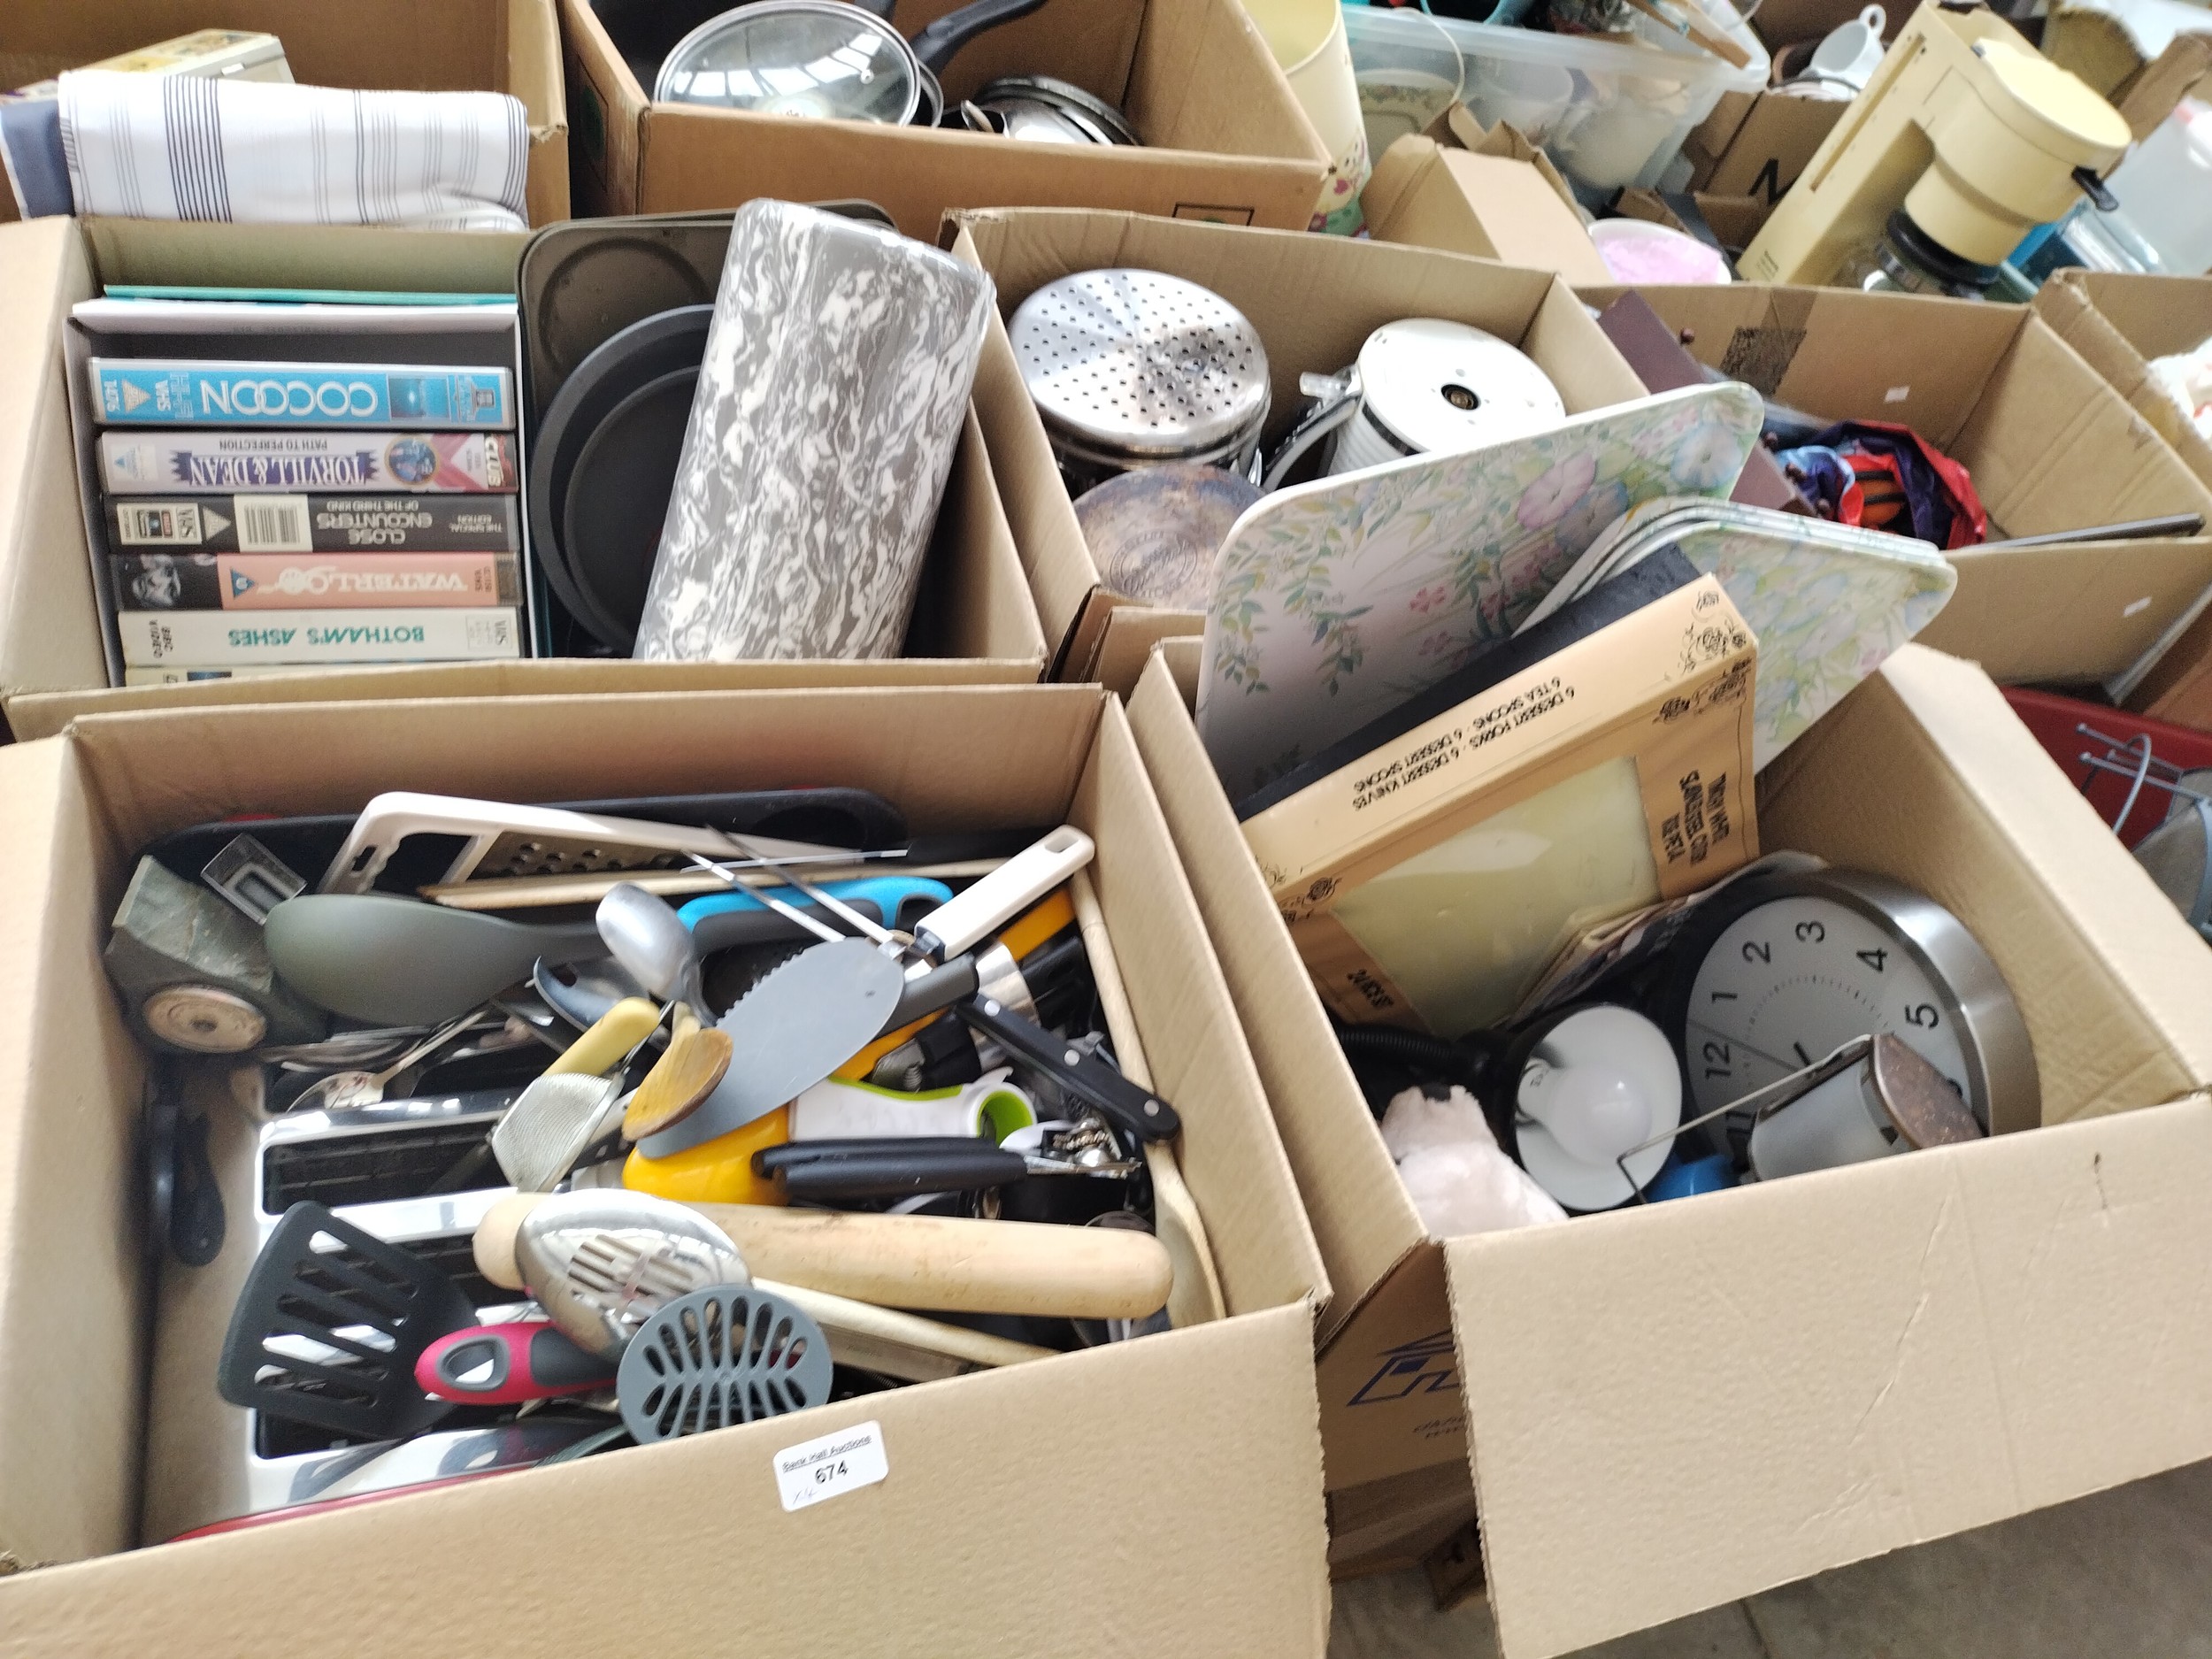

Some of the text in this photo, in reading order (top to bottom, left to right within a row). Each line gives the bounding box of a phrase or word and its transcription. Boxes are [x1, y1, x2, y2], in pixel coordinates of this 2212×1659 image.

[155, 380, 170, 412] VHS
[201, 379, 379, 419] COCOON
[219, 439, 328, 451] PATH TO PERFECTION
[188, 456, 252, 486] DEAN
[254, 455, 267, 485] &
[270, 456, 365, 486] TORVILL
[326, 500, 419, 511] OF THE THIRD KIND
[317, 511, 433, 530] ENCOUNTERS
[486, 523, 503, 533] THE
[348, 529, 406, 545] CLOSE
[228, 625, 425, 647] BOTHAM'S ASHES
[1355, 675, 1561, 794] 6 TEA SPOONS 6 DESSERT SPOONS
[1353, 685, 1575, 810] 6 DESSERT FORKS 6 DESSERT KNIVES
[1794, 920, 1825, 944] 3
[1742, 941, 1770, 964] 2
[1856, 948, 1888, 972] 4
[1711, 991, 1738, 1004] 1
[1905, 1002, 1939, 1029] 5
[1702, 1041, 1732, 1079] 12
[782, 1434, 872, 1472] Bank Hall Auctions
[815, 1460, 849, 1485] 674
